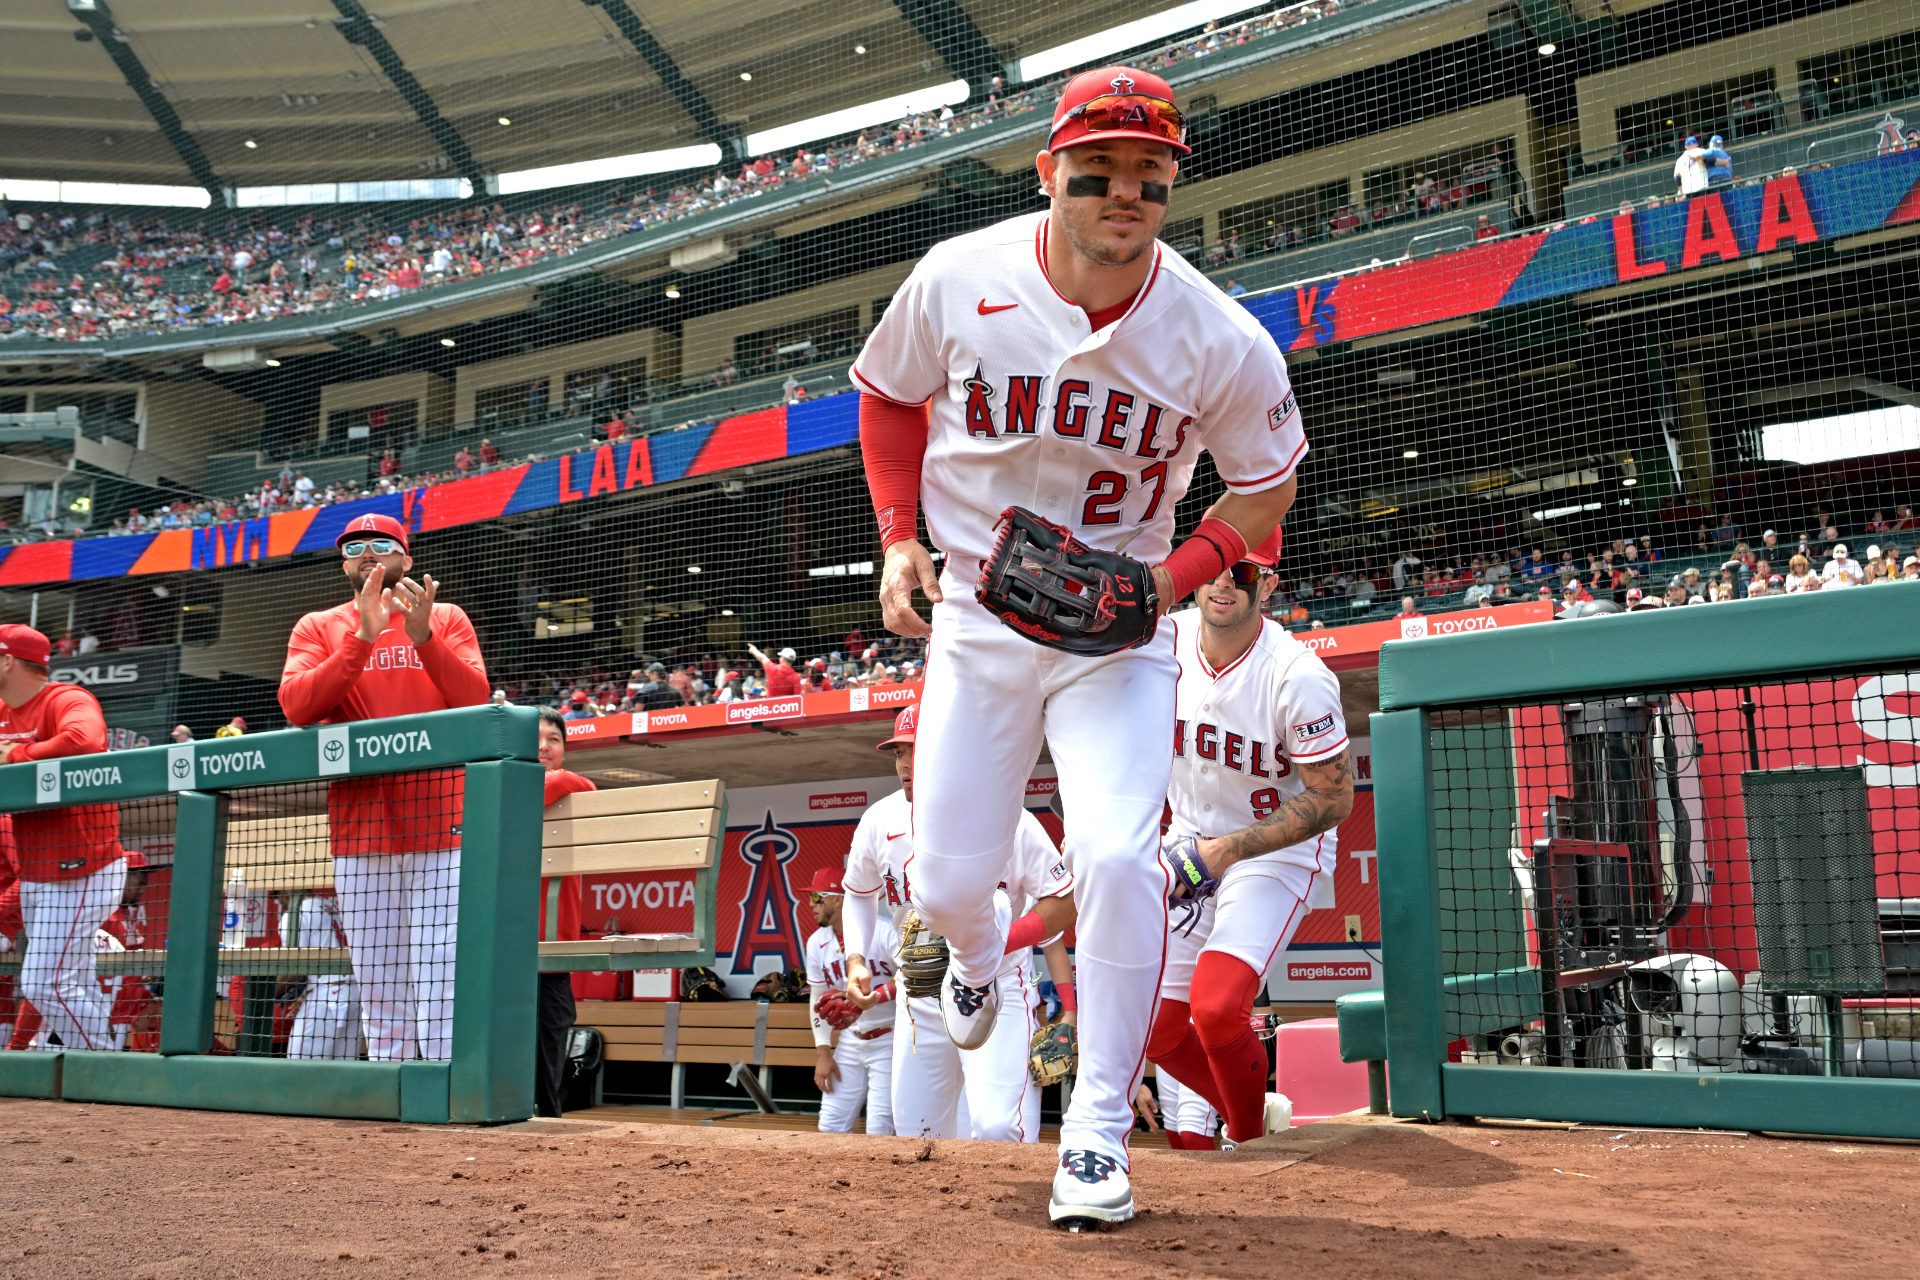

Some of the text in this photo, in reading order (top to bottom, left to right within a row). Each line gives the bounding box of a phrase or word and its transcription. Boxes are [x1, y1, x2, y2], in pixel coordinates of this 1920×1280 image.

[1612, 175, 1819, 282] LAA
[1296, 286, 1337, 343] VS
[962, 360, 1194, 460] ANGELS
[559, 437, 654, 503] LAA
[1081, 460, 1169, 526] 27
[402, 489, 424, 532] VS
[190, 516, 271, 569] NYM
[1115, 574, 1135, 594] 27
[1433, 616, 1498, 635] TOYOTA
[50, 664, 139, 686] EXUS
[872, 689, 916, 703] TOYOTA
[651, 713, 688, 727] TOYOTA
[730, 701, 799, 719] angels.com
[566, 724, 596, 736] OYOTA
[1310, 717, 1332, 734] FBM
[356, 731, 432, 758] TOYOTA
[200, 750, 266, 776] TOYOTA
[64, 766, 122, 789] TOYOTA
[811, 793, 866, 808] angels.com
[1250, 787, 1281, 820] 9
[590, 880, 695, 911] TOYOTA
[913, 947, 940, 956] A2000
[821, 958, 893, 988] ANLS
[1290, 965, 1369, 979] angels.com
